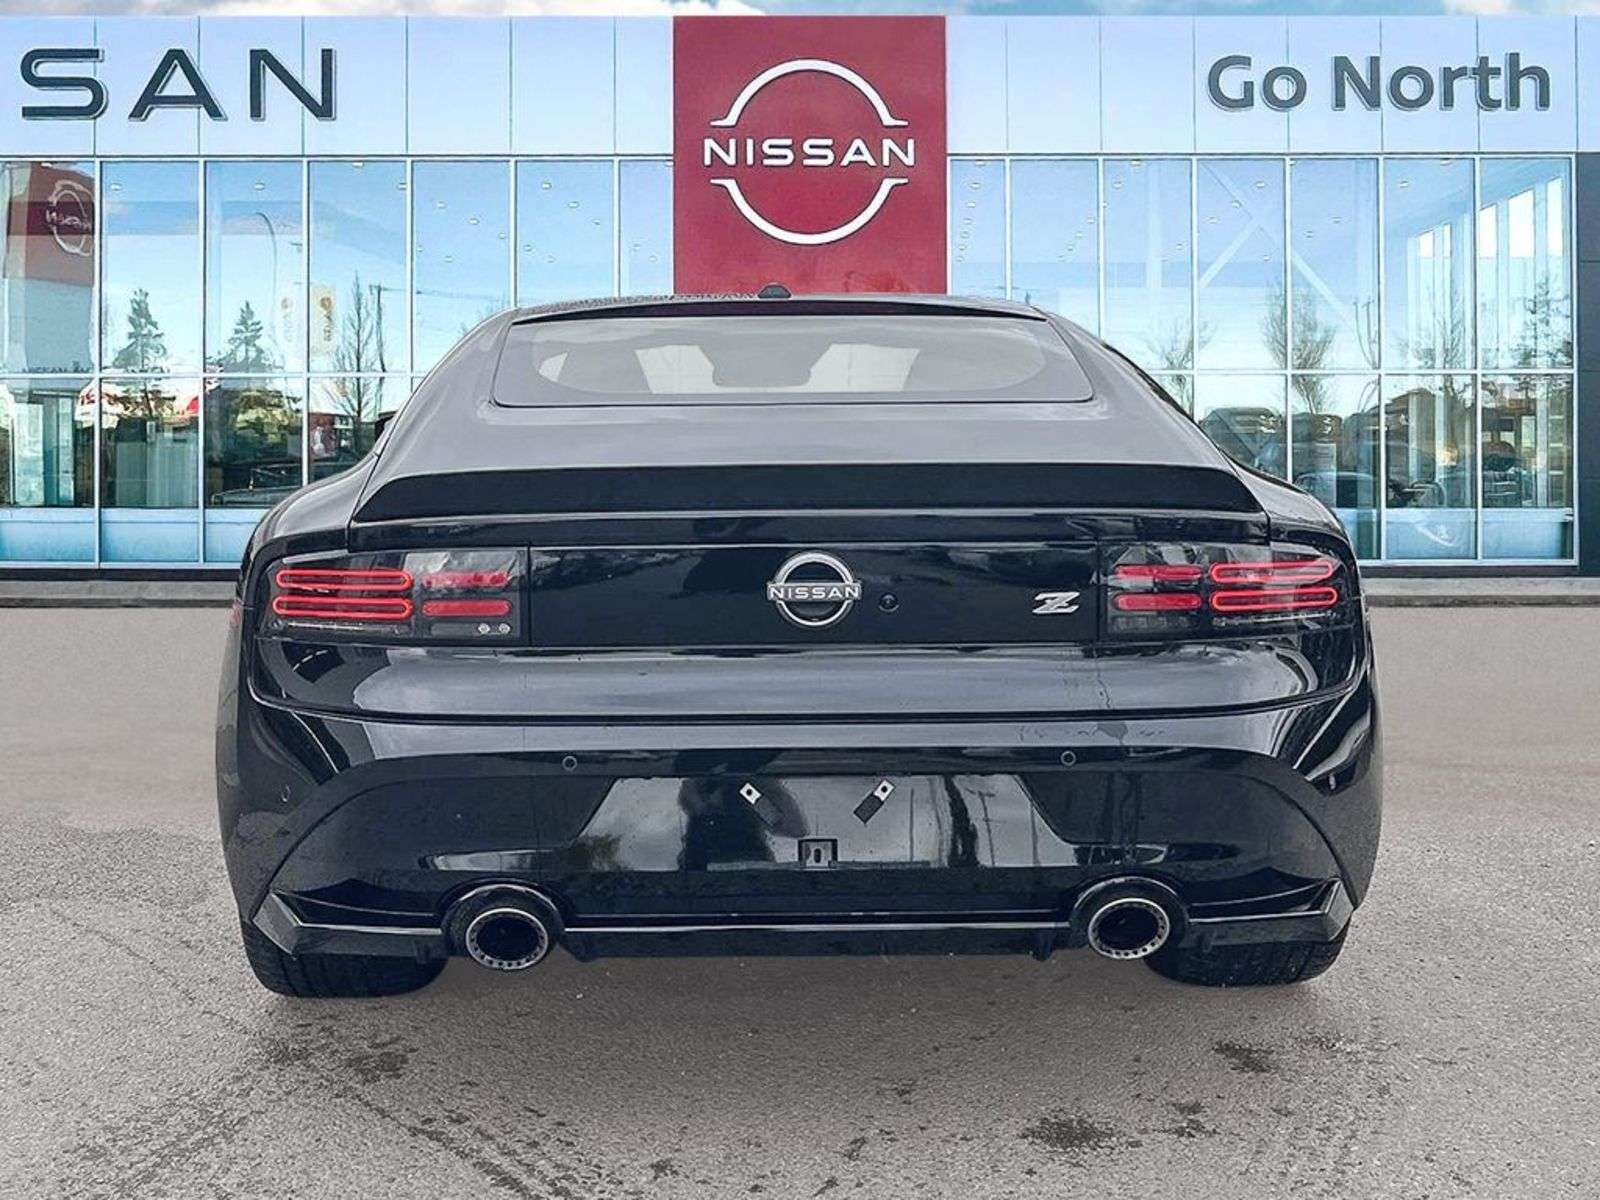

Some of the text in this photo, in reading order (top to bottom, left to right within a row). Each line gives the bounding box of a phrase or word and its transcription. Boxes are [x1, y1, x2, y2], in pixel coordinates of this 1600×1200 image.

[20, 47, 338, 121] SAN
[1206, 52, 1552, 112] Go North
[703, 137, 916, 168] NISSAN
[769, 586, 860, 600] NISSAN
[1031, 591, 1081, 615] Z
